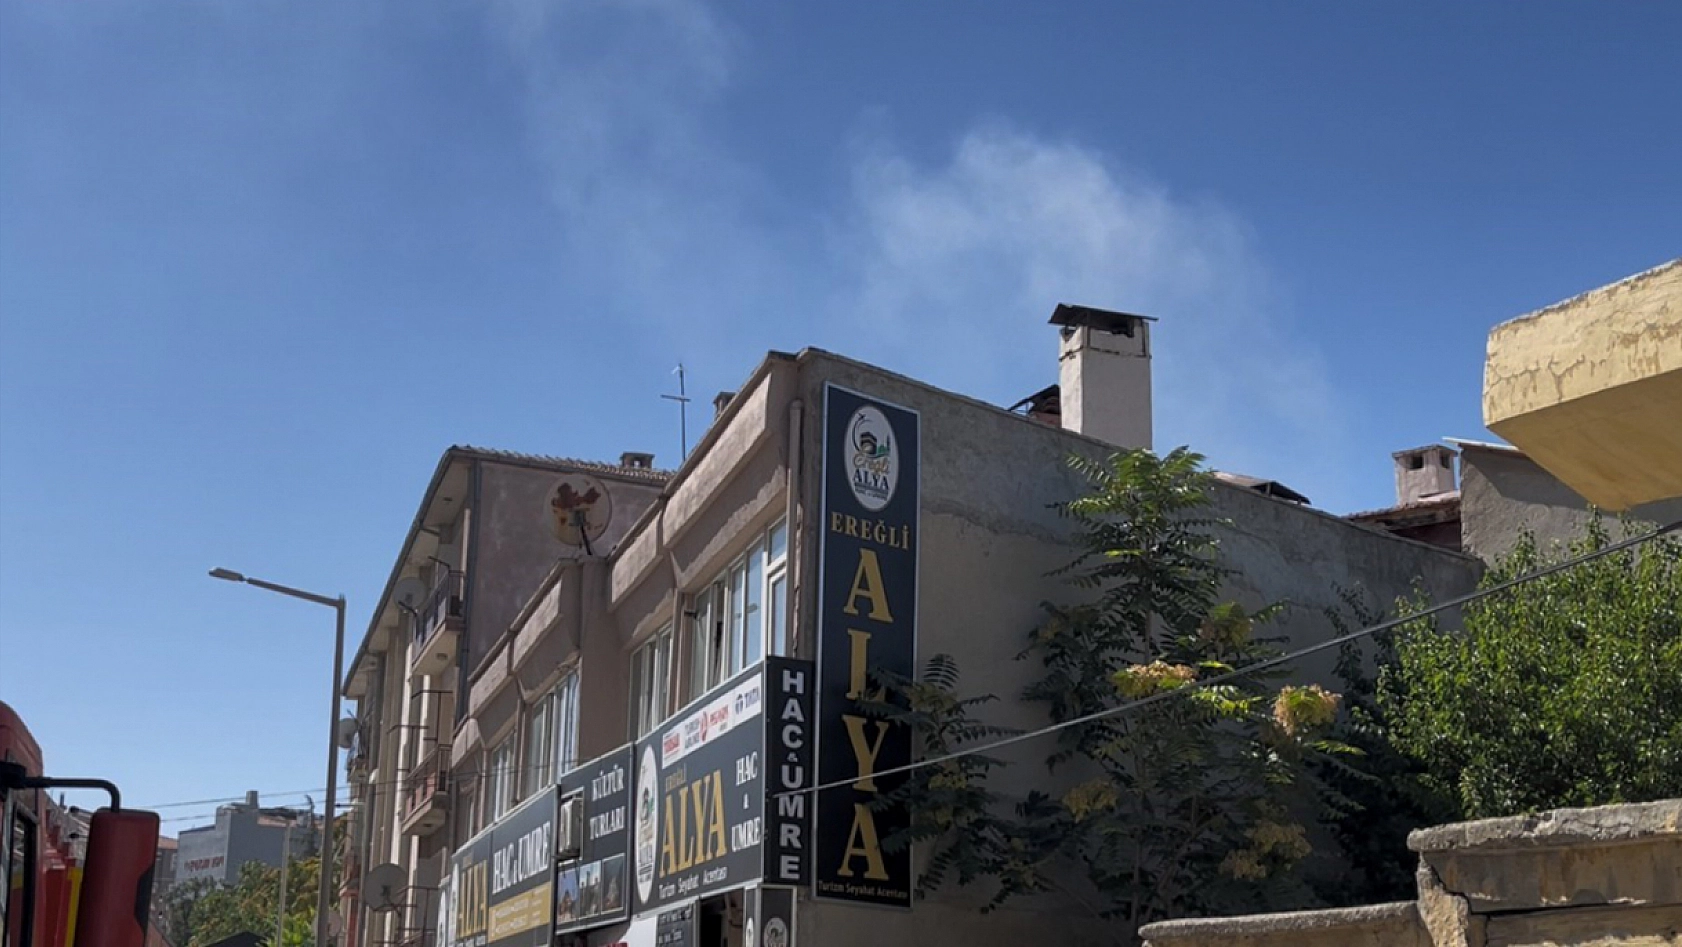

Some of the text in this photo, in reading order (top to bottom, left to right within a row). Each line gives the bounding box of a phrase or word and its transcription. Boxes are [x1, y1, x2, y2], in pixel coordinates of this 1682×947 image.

[853, 468, 889, 490] ALYA
[831, 511, 909, 551] EREĞLİ
[837, 548, 894, 881] ALYA
[592, 764, 624, 802] KÜLTÜR
[735, 751, 757, 786] HAC
[778, 669, 804, 879] HAC & UMRE
[659, 769, 727, 878] ALYA
[731, 817, 760, 852] UMRE
[492, 842, 514, 895] HAC
[518, 820, 551, 882] UMRE
[456, 860, 487, 940] ALYA
